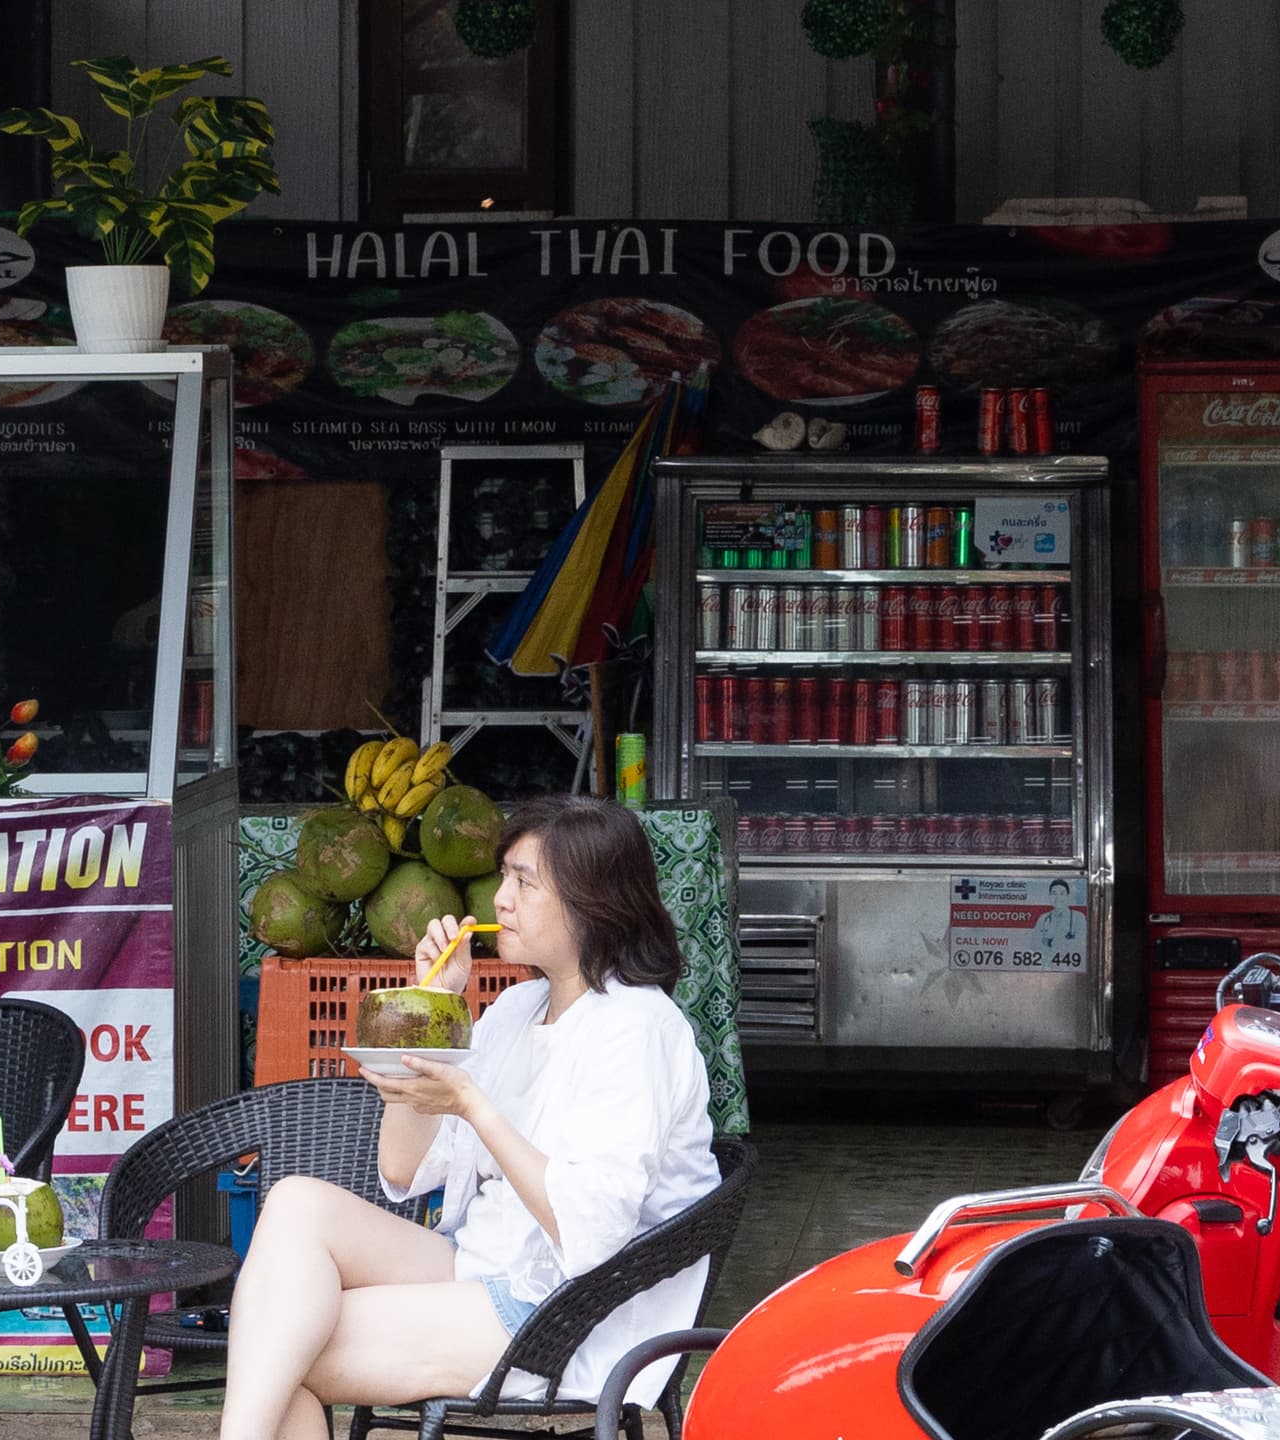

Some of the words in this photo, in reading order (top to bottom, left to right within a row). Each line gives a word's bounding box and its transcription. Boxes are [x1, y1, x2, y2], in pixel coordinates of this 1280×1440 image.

[305, 230, 489, 279] HALAL
[530, 226, 680, 277] THAI
[722, 229, 897, 277] FOOD
[292, 421, 362, 435] STEAMED
[370, 421, 400, 435] SEA
[407, 421, 448, 434] BASS
[454, 421, 496, 434] WITH
[504, 421, 557, 434] LEMON
[953, 911, 980, 920] NEED
[983, 911, 1032, 921] DOCTOR?
[956, 936, 980, 946] CALL
[982, 937, 1009, 946] NOW!
[973, 950, 1004, 966] 076
[1012, 951, 1042, 967] 582
[1051, 952, 1082, 968] 449
[78, 1023, 153, 1063] OK
[66, 1093, 146, 1133] ERE
